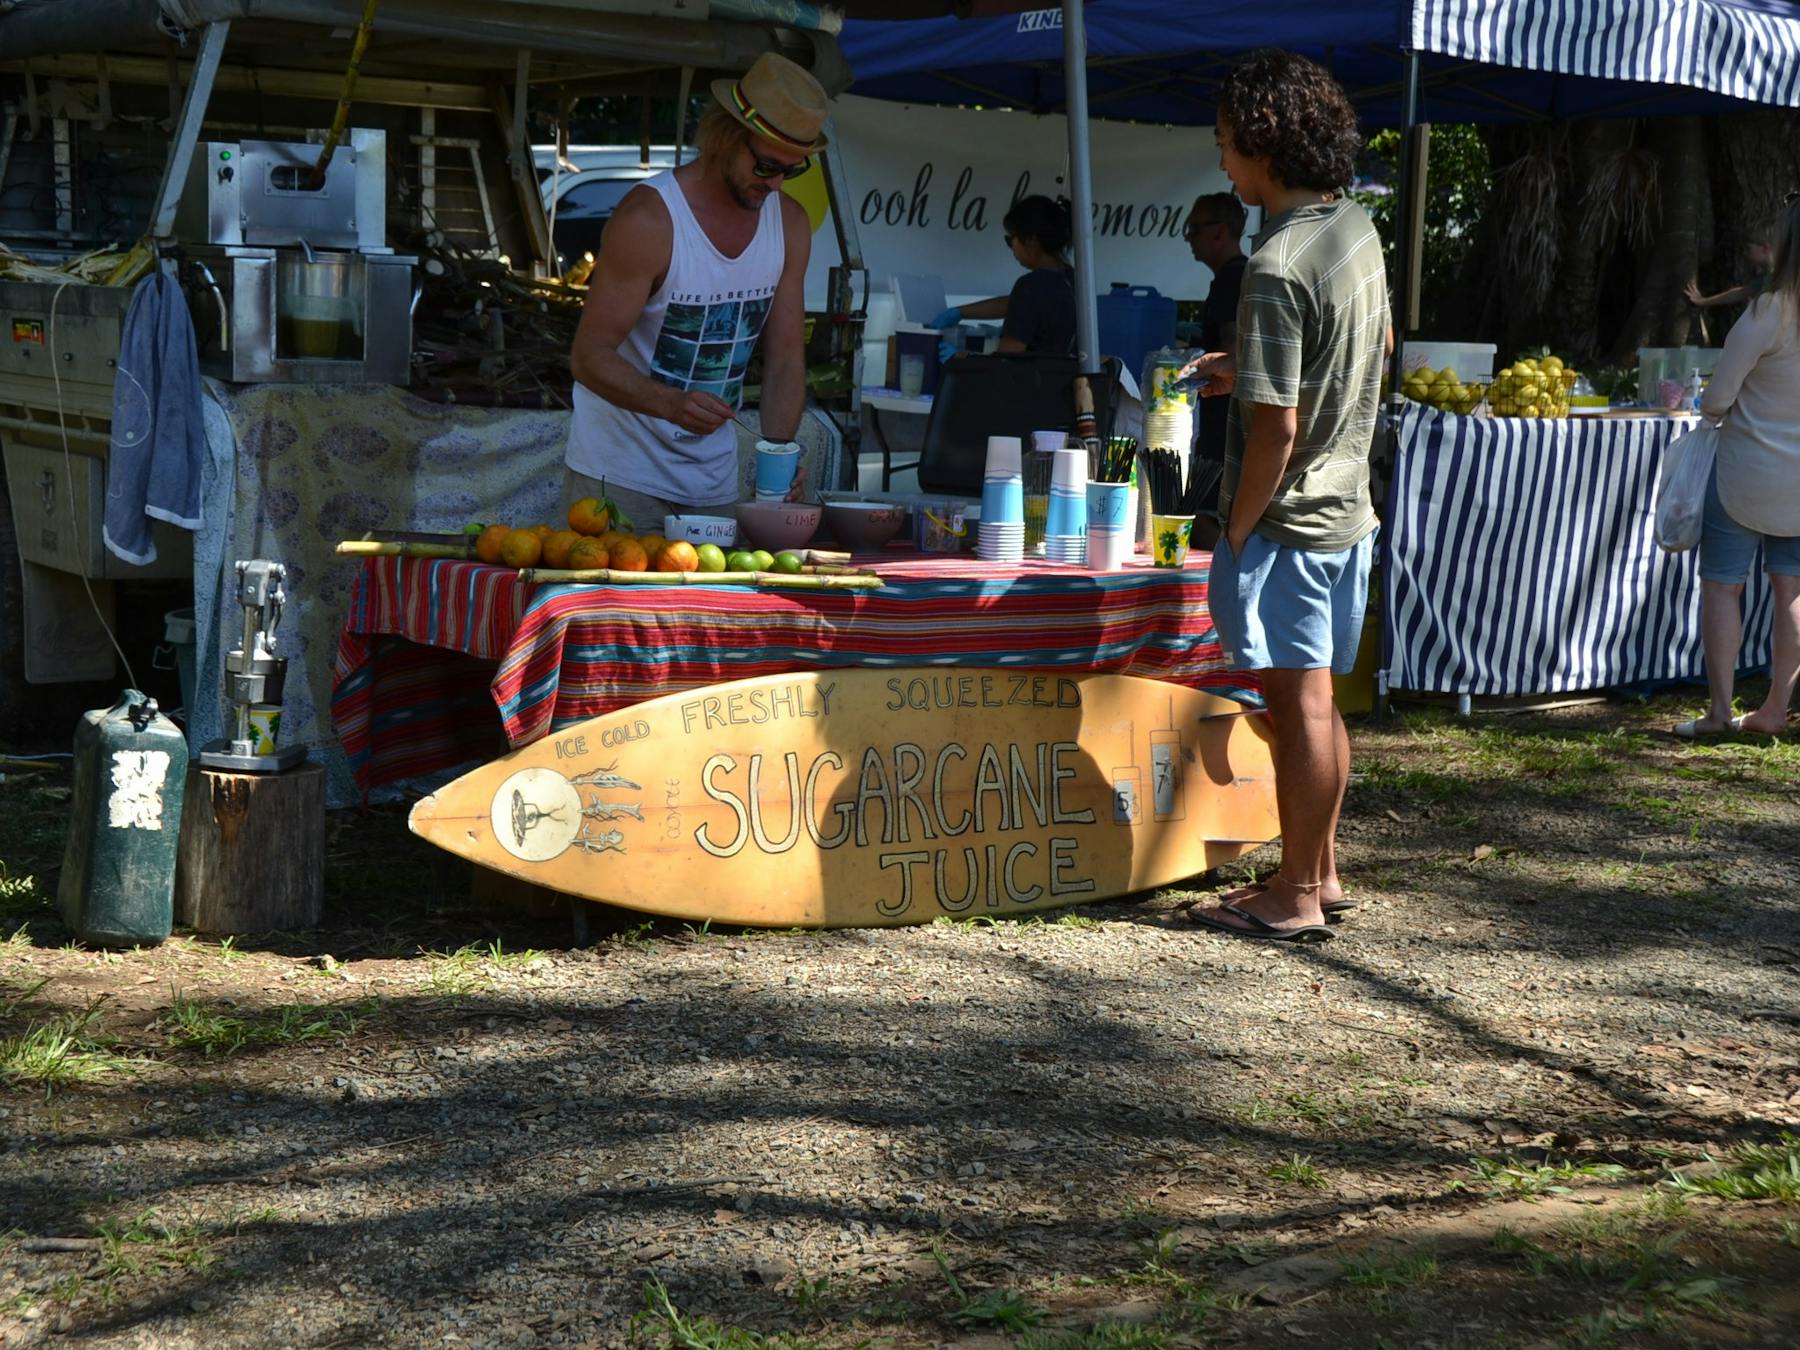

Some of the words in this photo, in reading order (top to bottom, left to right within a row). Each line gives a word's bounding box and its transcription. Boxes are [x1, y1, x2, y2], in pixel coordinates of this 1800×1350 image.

[859, 161, 934, 229] ooh
[946, 165, 989, 232] la
[670, 291, 702, 303] LIFE
[709, 293, 722, 303] IS
[785, 513, 817, 527] LIME
[680, 681, 837, 735] FRESHLY
[886, 675, 1083, 712] SQUEEZED
[555, 736, 589, 760] ICE
[601, 720, 651, 749] COLD
[694, 741, 1097, 859] SUGARCANE
[874, 836, 1096, 918] JUICE
